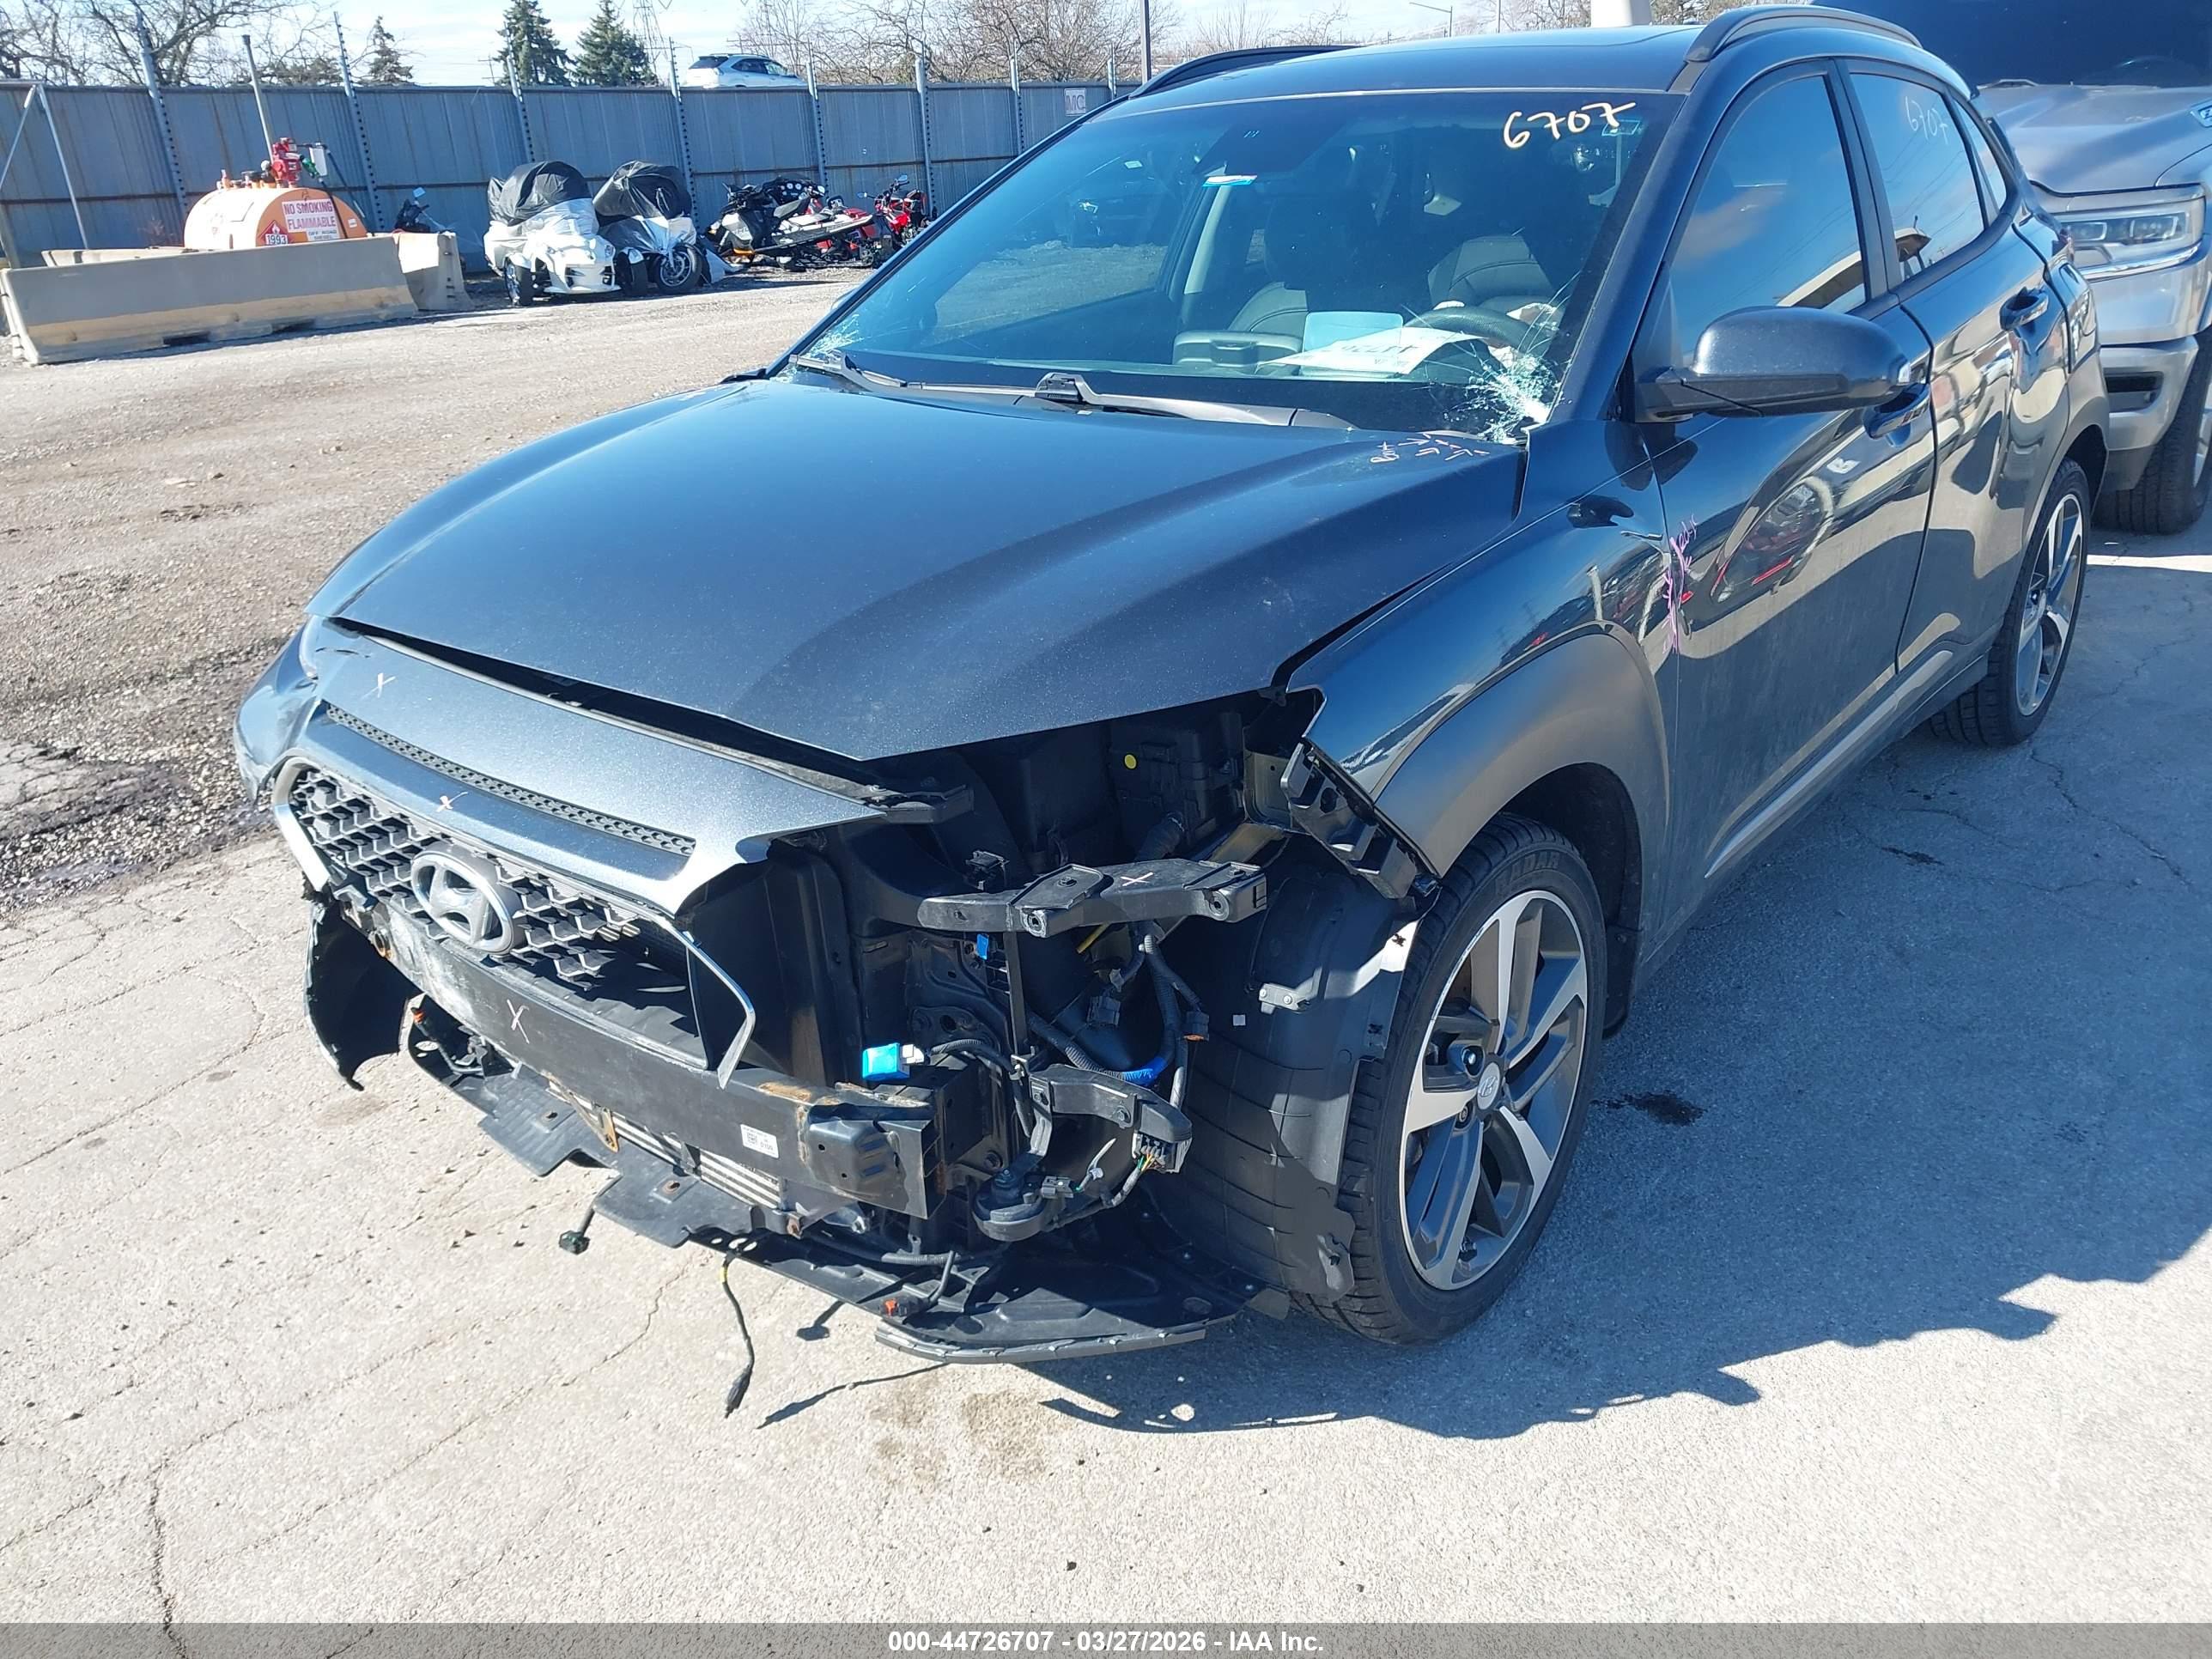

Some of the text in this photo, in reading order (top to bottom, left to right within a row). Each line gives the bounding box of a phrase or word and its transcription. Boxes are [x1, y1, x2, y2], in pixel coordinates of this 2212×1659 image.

[1504, 102, 1636, 149] 6707
[1905, 95, 1948, 145] 6707
[283, 201, 333, 215] NO SMOKING
[288, 216, 337, 230] FLAMMABLE
[267, 234, 287, 245] 1993
